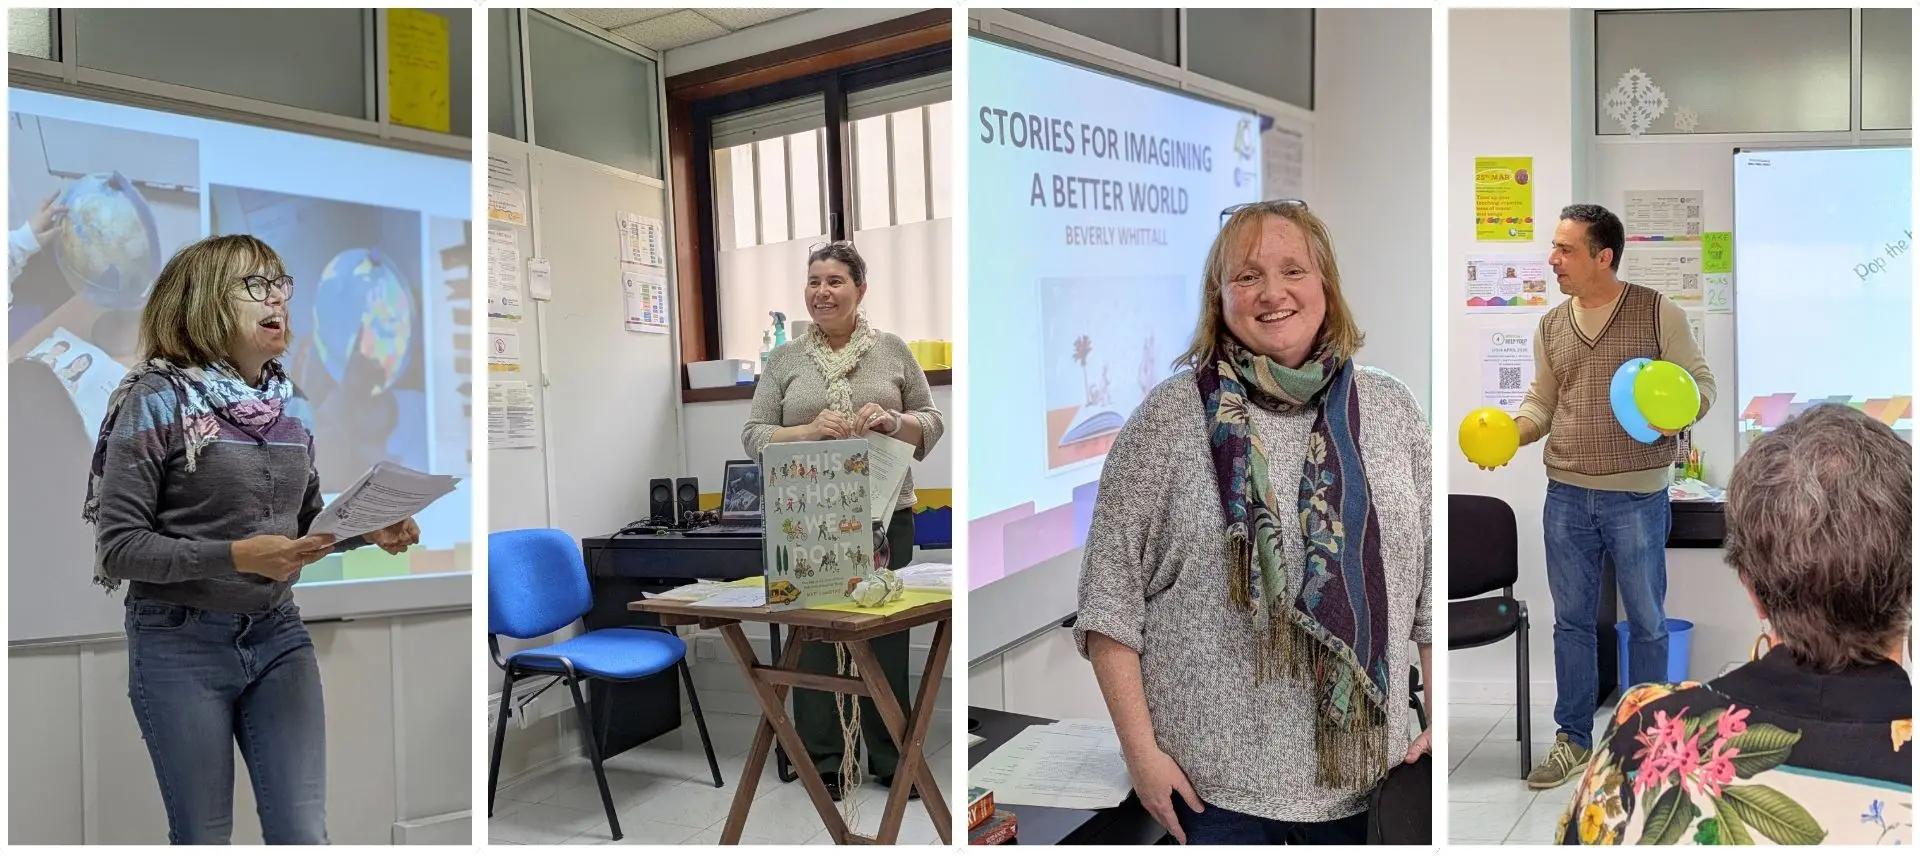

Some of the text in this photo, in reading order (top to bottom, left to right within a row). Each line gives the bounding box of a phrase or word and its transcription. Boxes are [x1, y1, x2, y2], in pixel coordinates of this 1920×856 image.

[979, 106, 1213, 173] STORIES FOR IMAGINING
[1030, 172, 1189, 215] A BETTER WORLD
[1065, 225, 1168, 246] BEVERLY WHITTALL
[1853, 240, 1910, 281] Pop the
[792, 452, 842, 472] THIS
[778, 480, 860, 504] IS HOW
[804, 513, 838, 535] WE
[793, 541, 853, 568] DO IT
